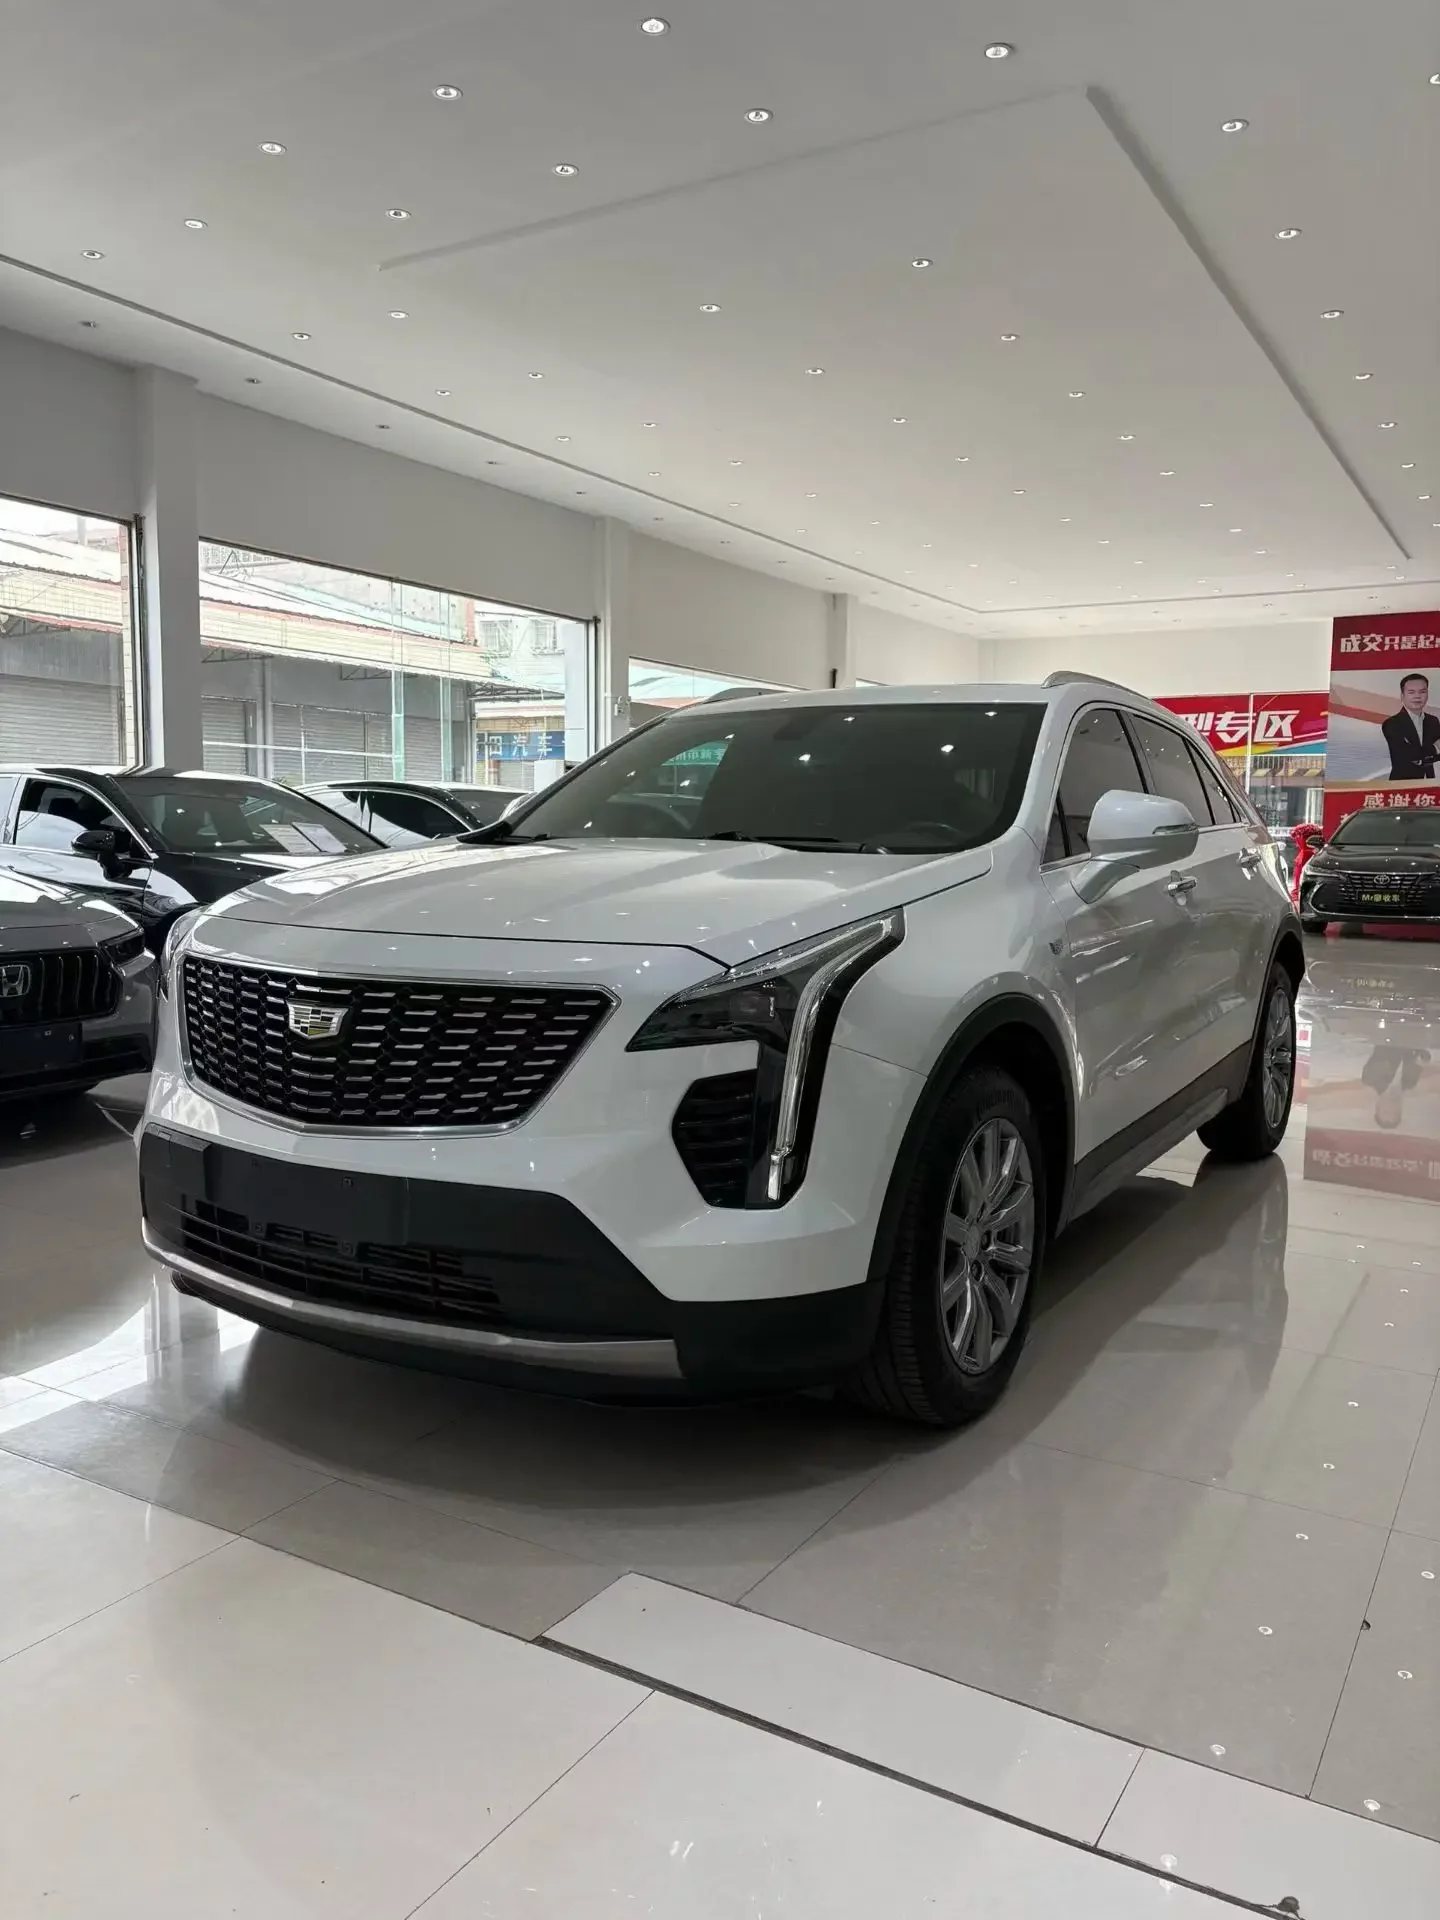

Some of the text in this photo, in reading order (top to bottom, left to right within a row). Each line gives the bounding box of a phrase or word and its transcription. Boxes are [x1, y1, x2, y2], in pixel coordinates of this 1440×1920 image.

[1340, 634, 1440, 652] 成交只是起
